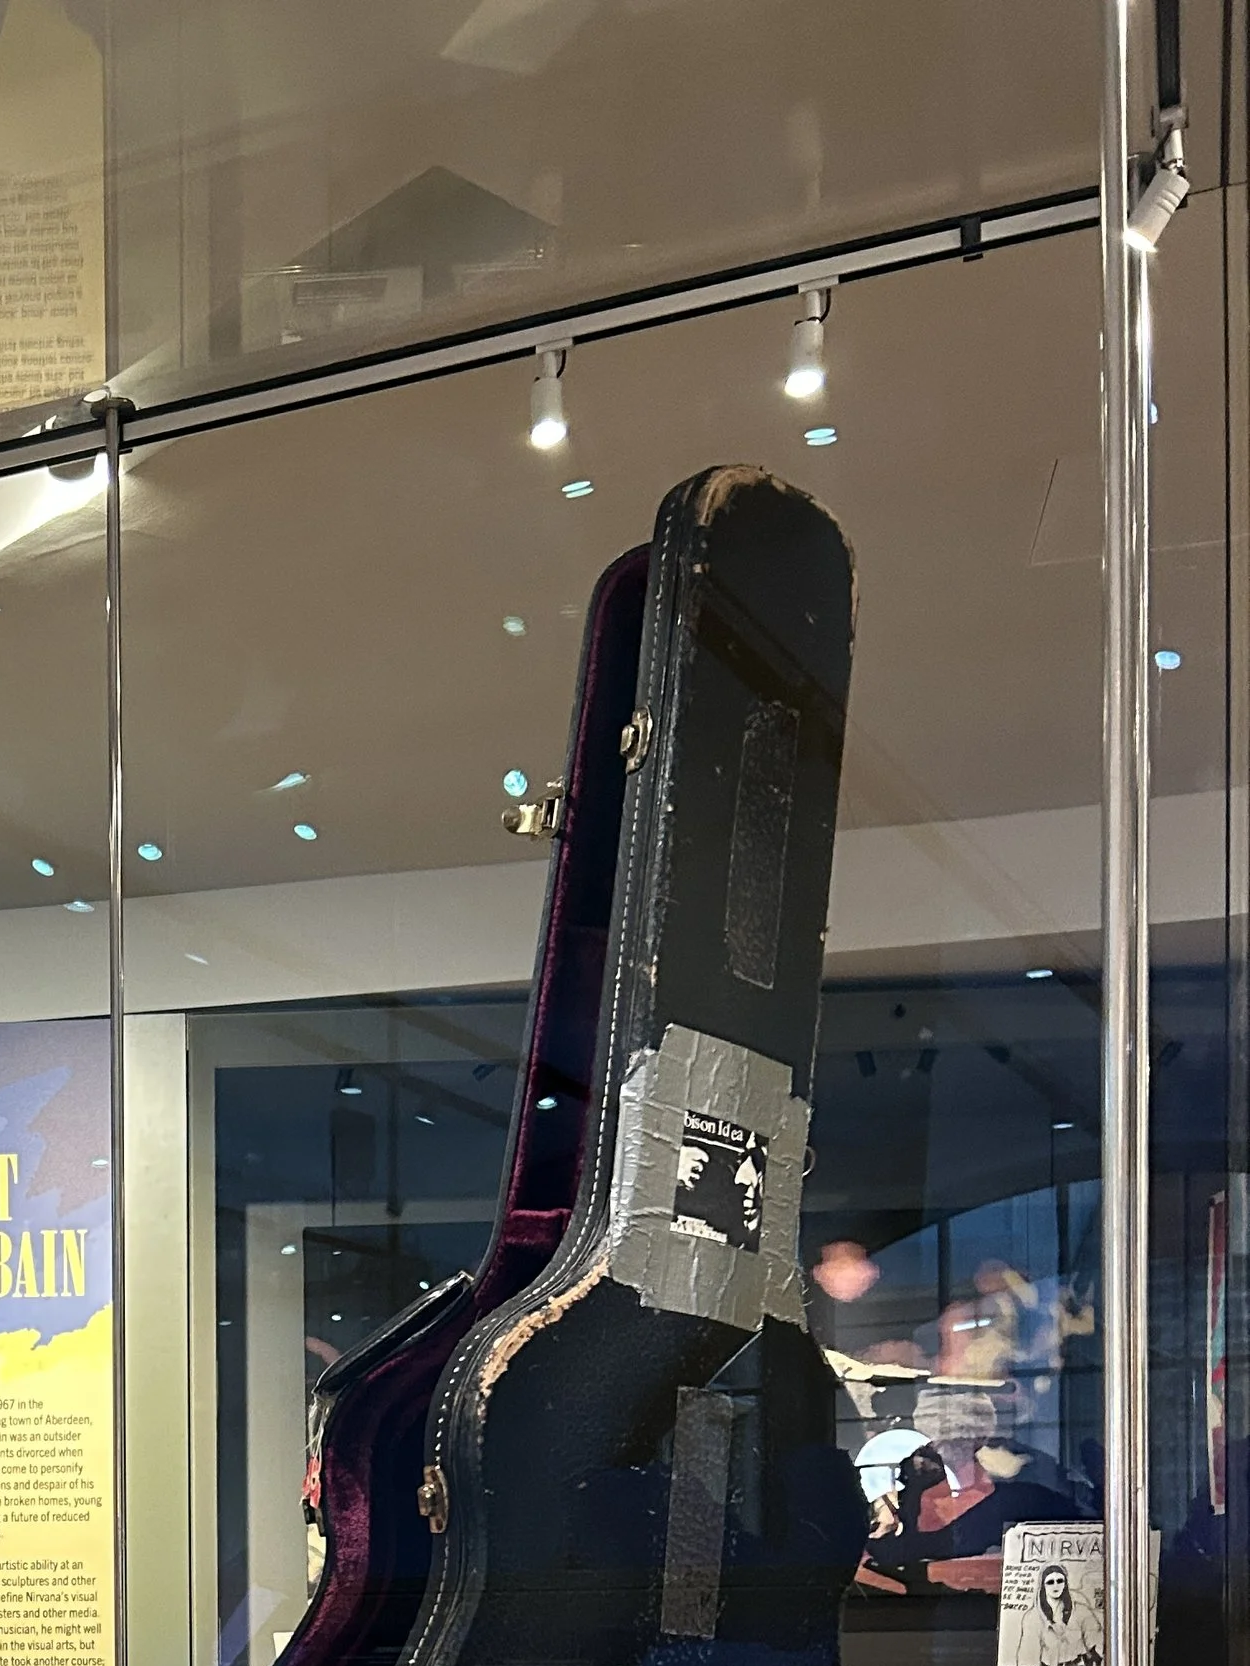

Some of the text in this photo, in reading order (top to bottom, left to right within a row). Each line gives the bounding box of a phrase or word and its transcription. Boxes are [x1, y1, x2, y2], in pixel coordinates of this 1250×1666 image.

[17, 1401, 26, 1409] in
[28, 1398, 43, 1409] the
[8, 1415, 31, 1425] town
[33, 1414, 43, 1425] of
[9, 1433, 27, 1441] was
[29, 1432, 40, 1441] an
[43, 1430, 81, 1441] outsider
[1030, 1539, 1103, 1557] NIRVA
